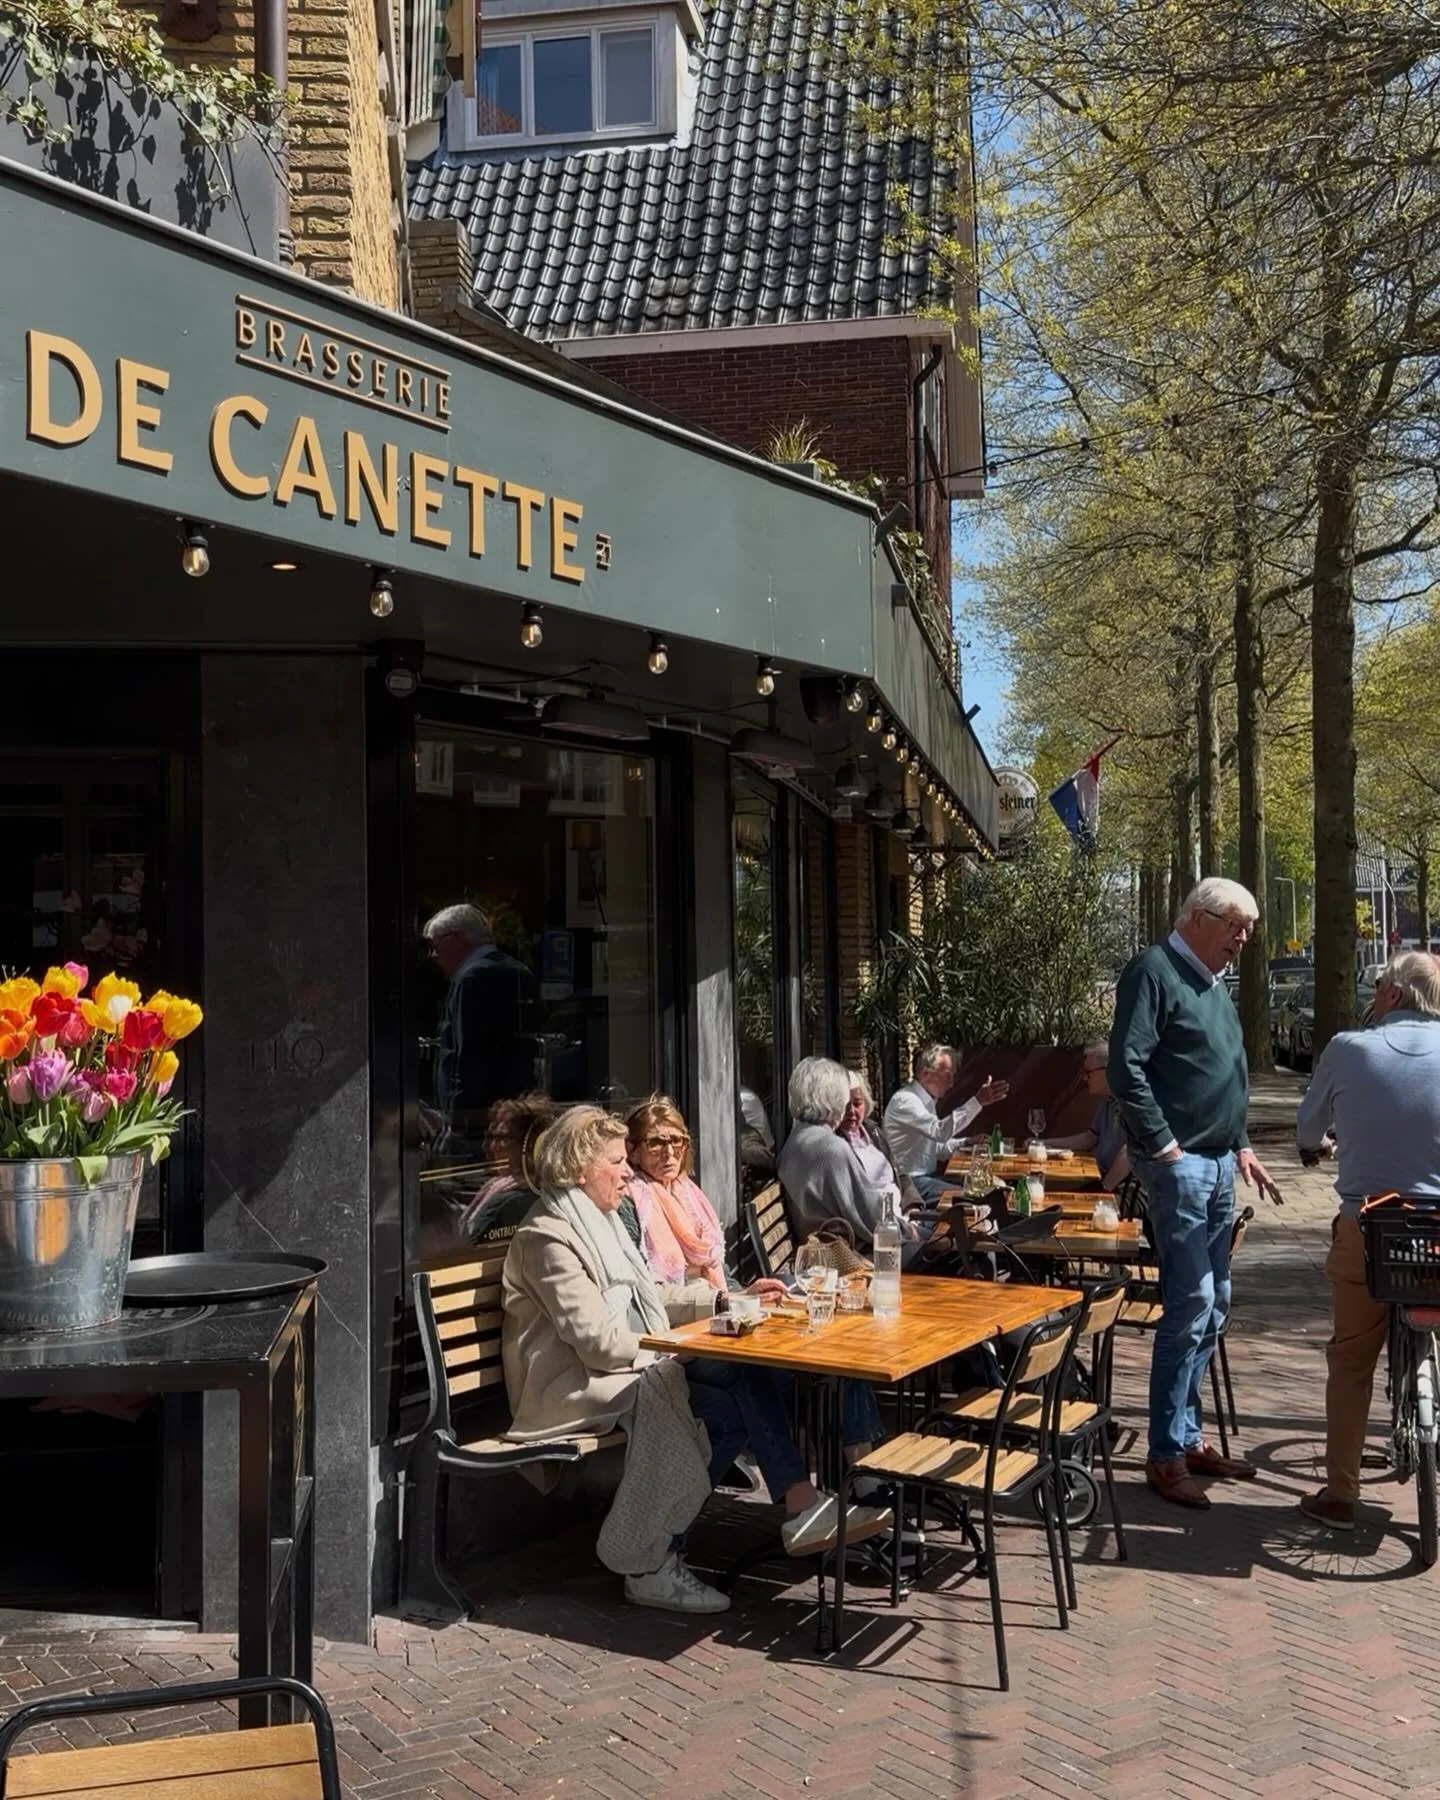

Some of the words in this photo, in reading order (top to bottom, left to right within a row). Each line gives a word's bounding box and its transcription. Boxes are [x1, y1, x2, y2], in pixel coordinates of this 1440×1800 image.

[236, 308, 453, 417] BRASSERIE
[27, 329, 174, 475] DE
[209, 394, 586, 584] CANETTE
[999, 792, 1036, 812] steiner
